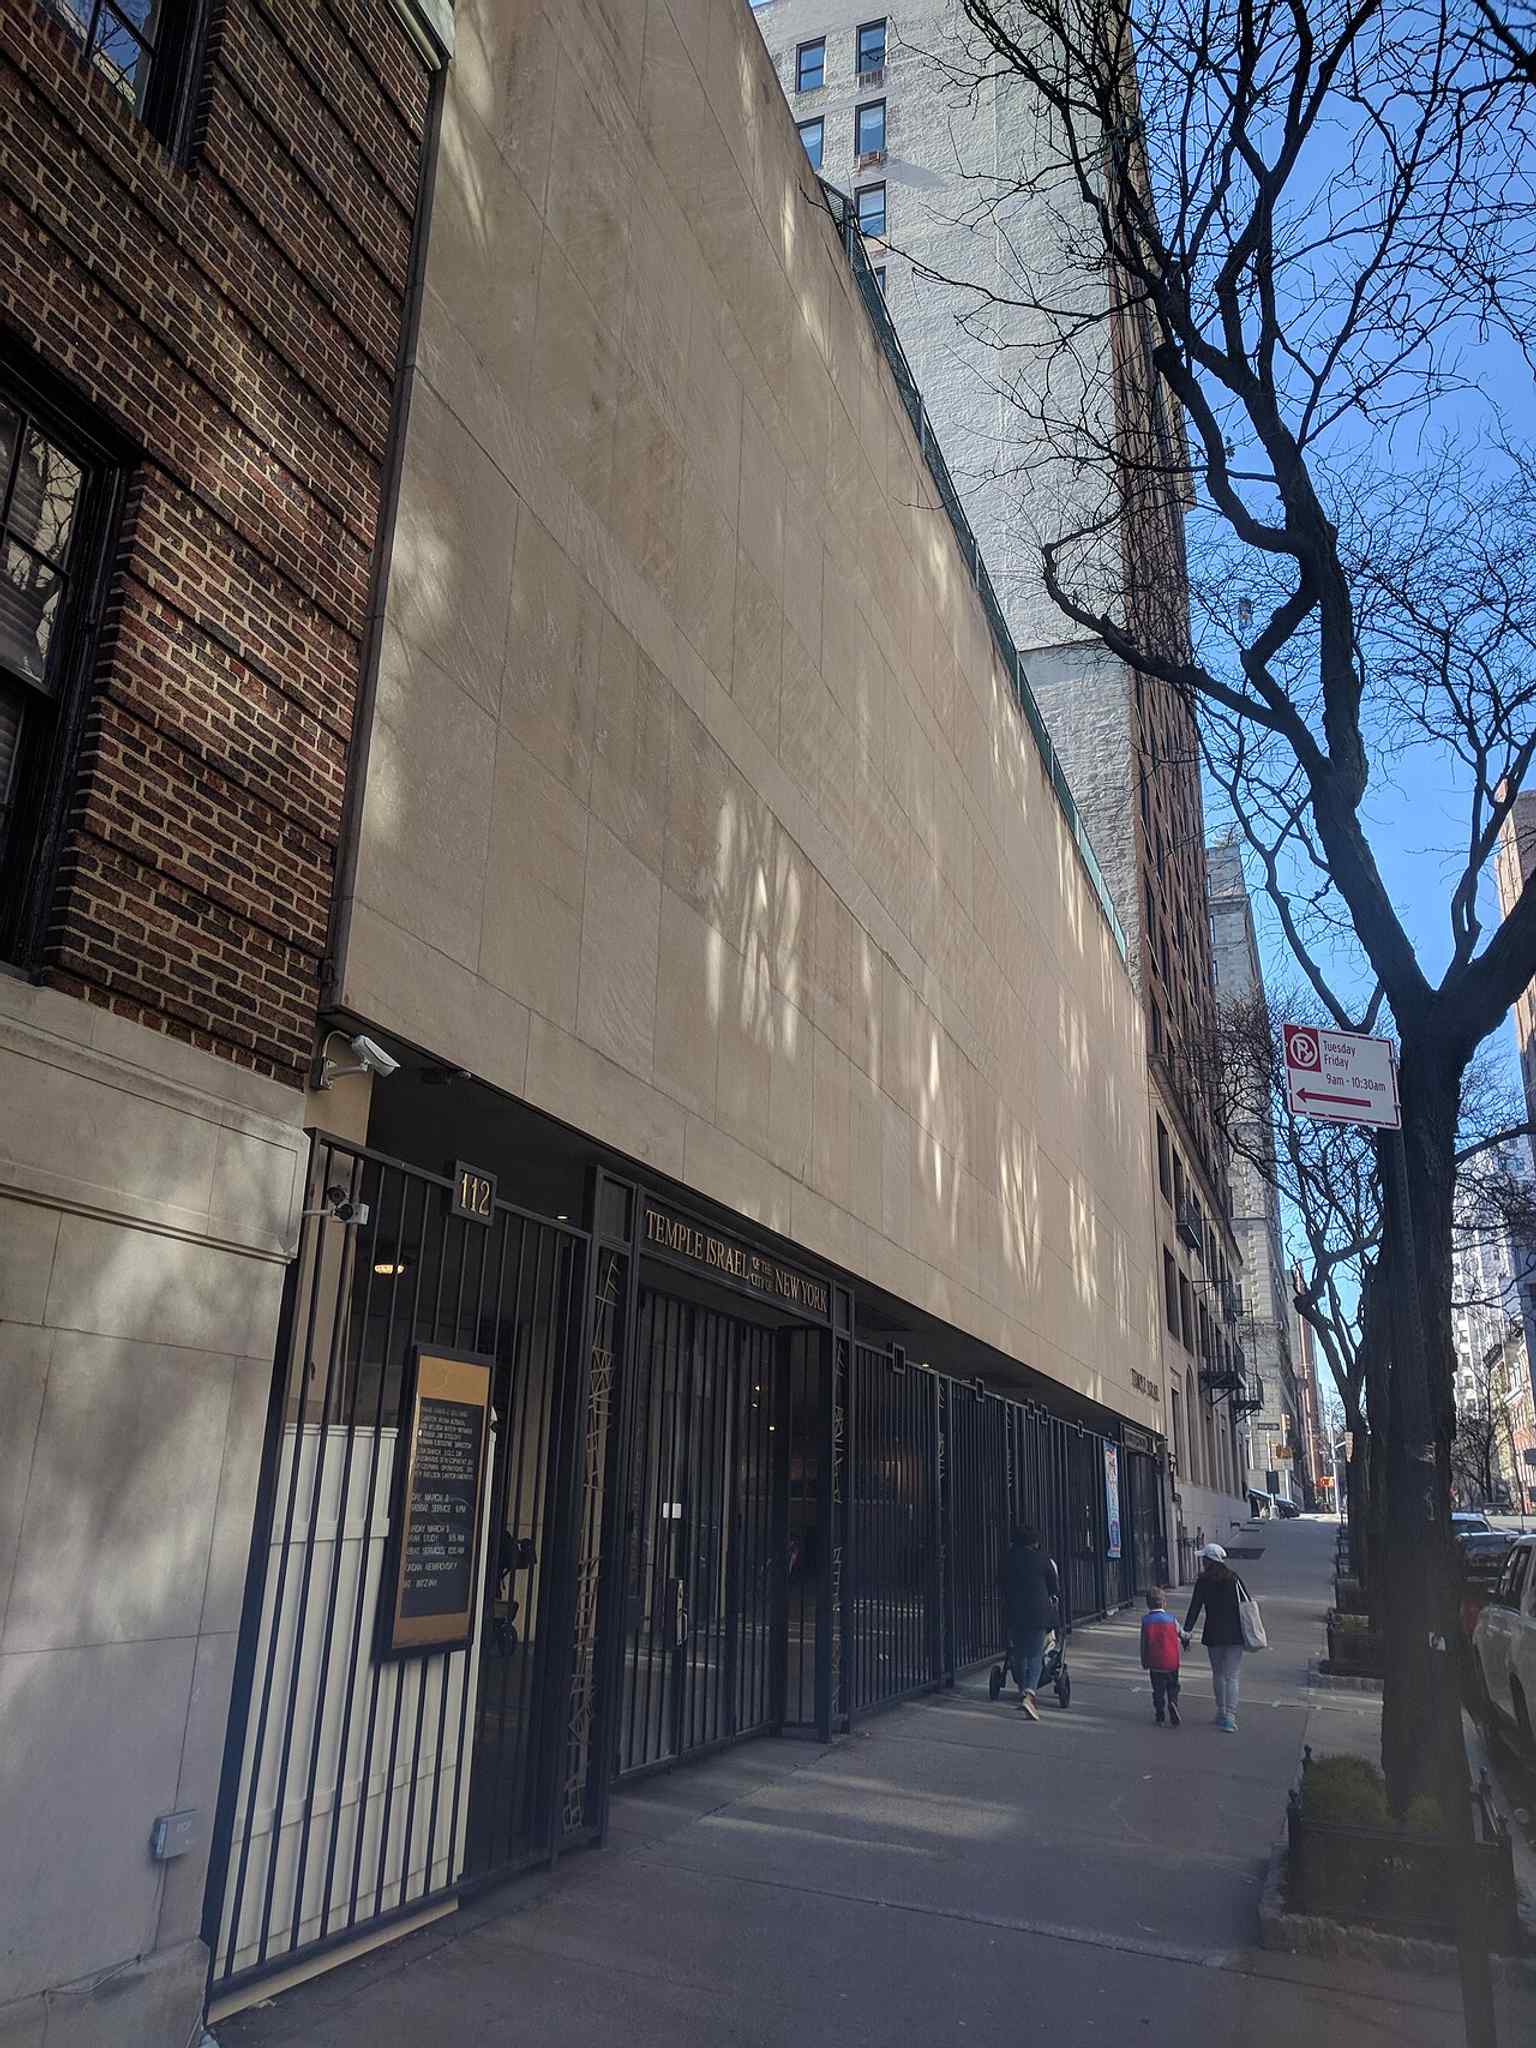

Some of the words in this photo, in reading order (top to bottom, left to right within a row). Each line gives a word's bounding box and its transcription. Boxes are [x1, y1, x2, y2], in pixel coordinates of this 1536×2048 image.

[1323, 1040, 1356, 1057] Tuesday
[1324, 1054, 1349, 1070] Friday
[1326, 1073, 1344, 1086] 9am
[1351, 1076, 1386, 1092] 10:30am
[460, 1172, 490, 1216] 112
[646, 1209, 704, 1260] TEMPLE
[705, 1236, 749, 1280] ISRAEL
[775, 1268, 801, 1302] NEW
[801, 1280, 828, 1313] YORK
